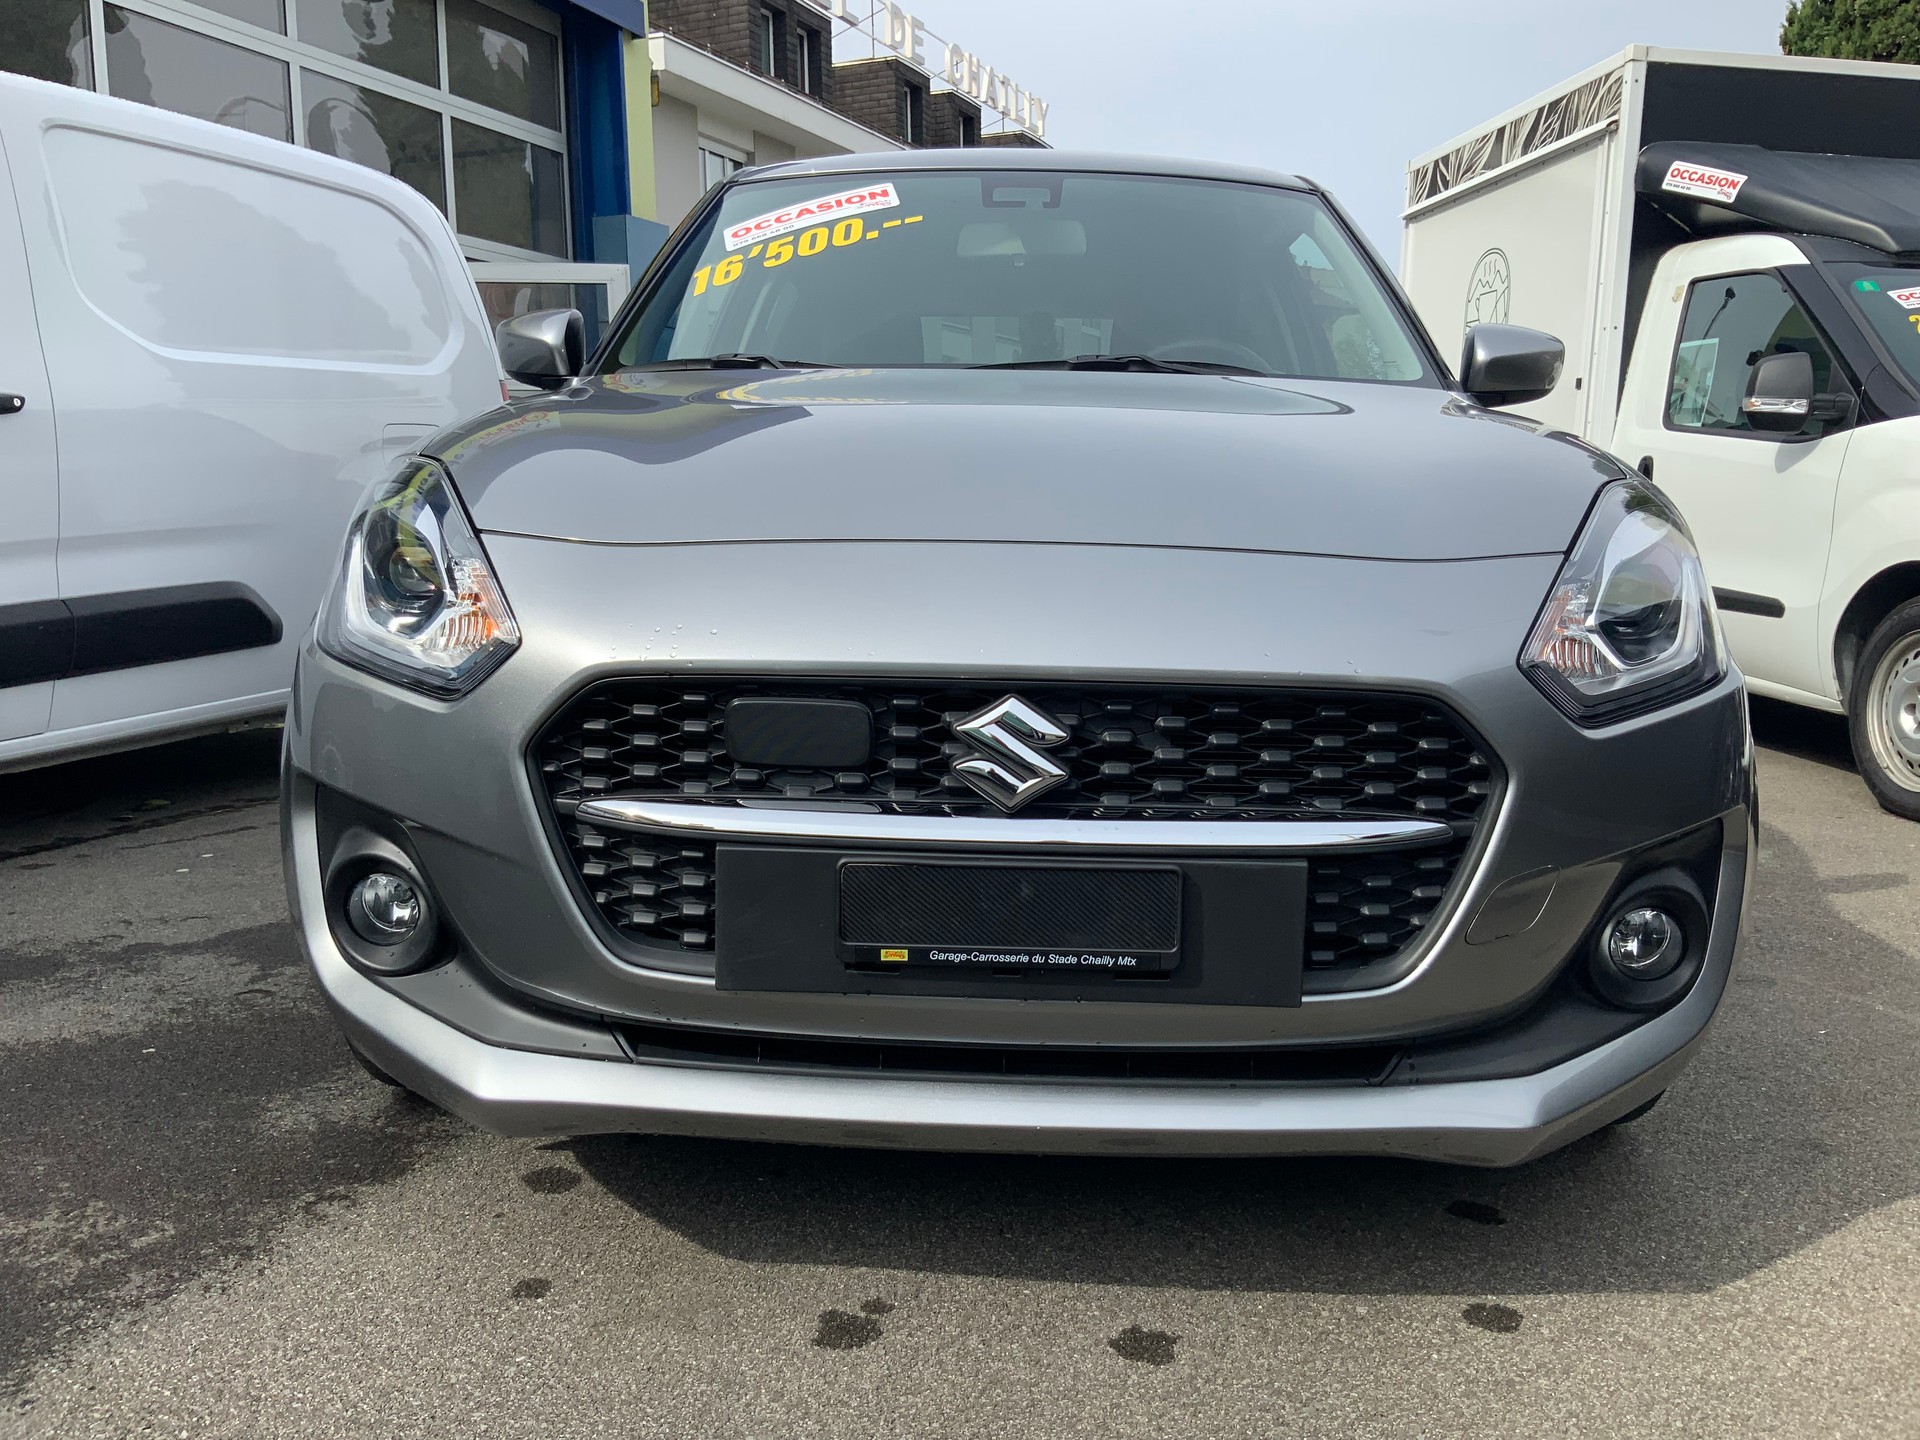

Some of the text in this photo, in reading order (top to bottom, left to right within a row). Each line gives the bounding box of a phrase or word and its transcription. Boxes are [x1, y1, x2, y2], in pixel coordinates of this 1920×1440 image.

[885, 1, 1049, 137] DE CHAILLY
[1671, 168, 1740, 190] OCCASION
[731, 188, 889, 239] OCCASION
[1897, 292, 1920, 301] OC
[929, 950, 1137, 967] Garage-Carrosserie du Stade Chailly Mtx
